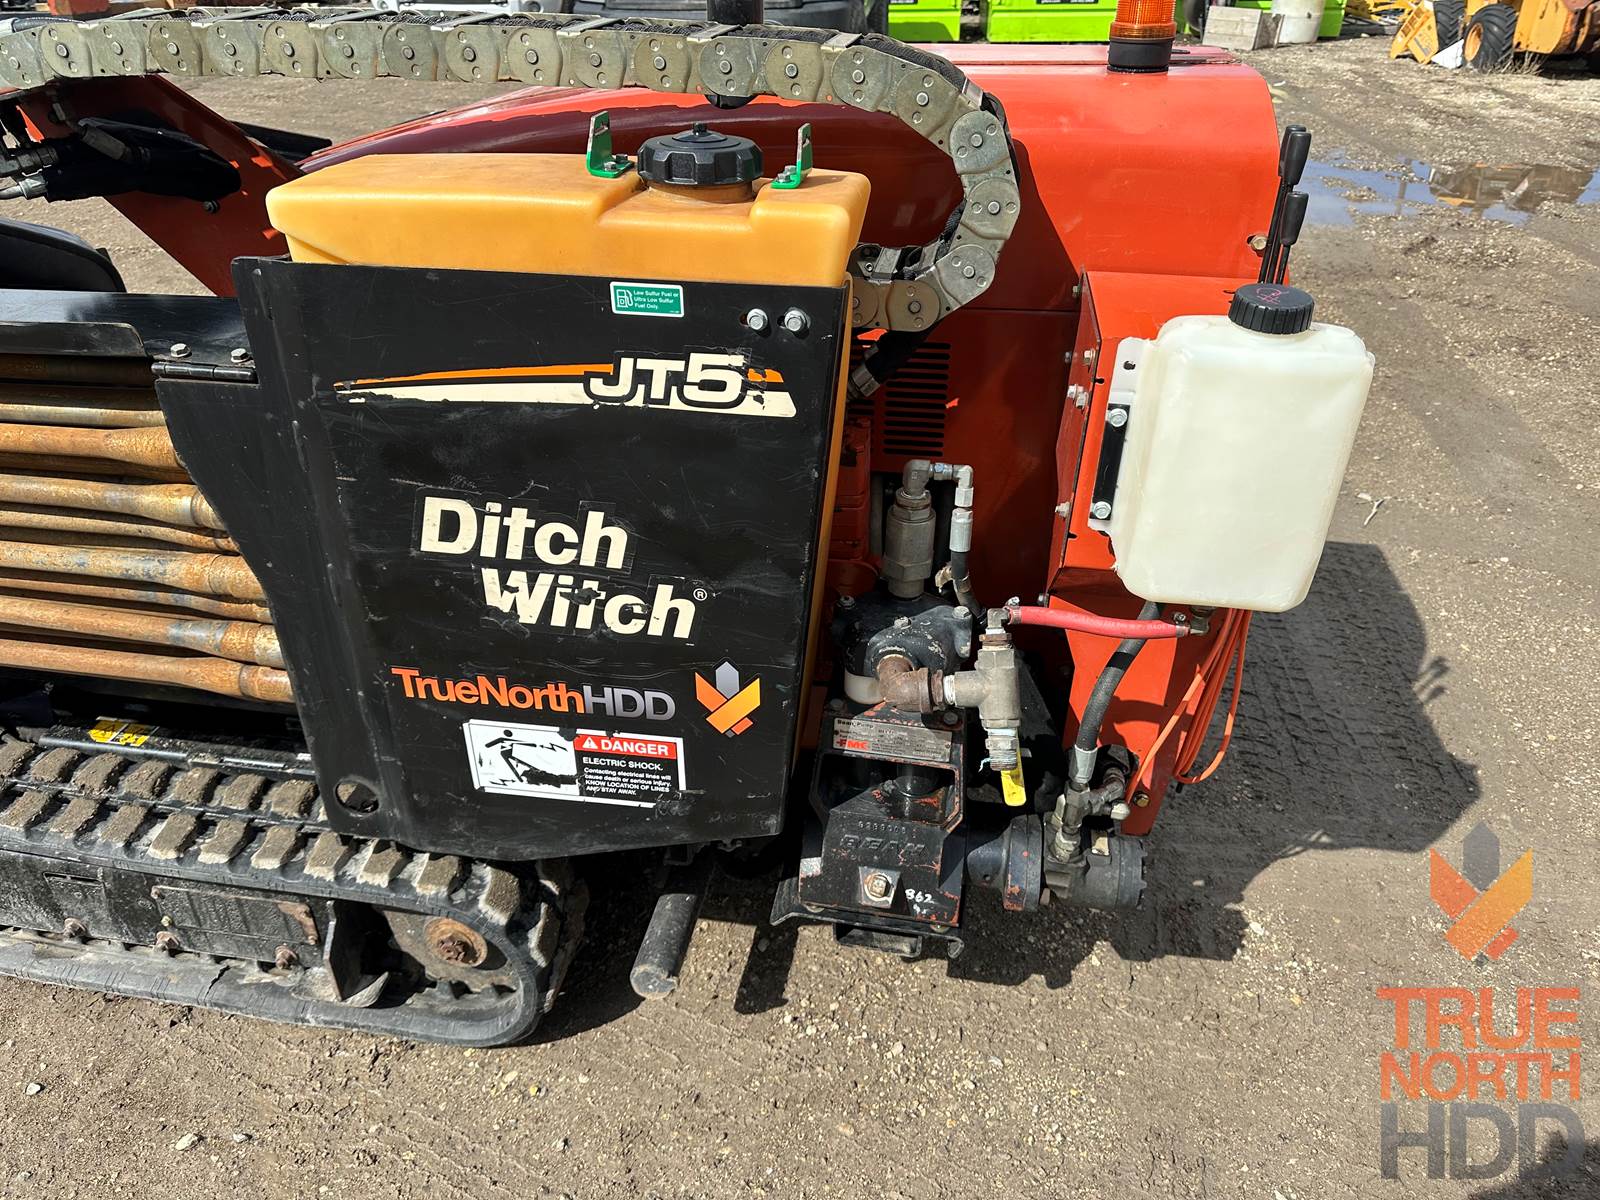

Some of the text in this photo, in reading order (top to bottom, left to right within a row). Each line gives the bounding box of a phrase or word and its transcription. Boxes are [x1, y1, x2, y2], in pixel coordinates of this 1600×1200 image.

[590, 352, 745, 403] JT5
[420, 496, 628, 569] Ditch
[391, 667, 676, 721] TrueNorthHDD
[601, 739, 669, 756] DANGER
[583, 757, 663, 771] ELECTRIC SHOCK.
[583, 767, 617, 776] Contacting
[617, 771, 645, 779] electrical
[645, 772, 660, 780] lines
[606, 781, 640, 790] LOCATION
[650, 785, 670, 793] LINES
